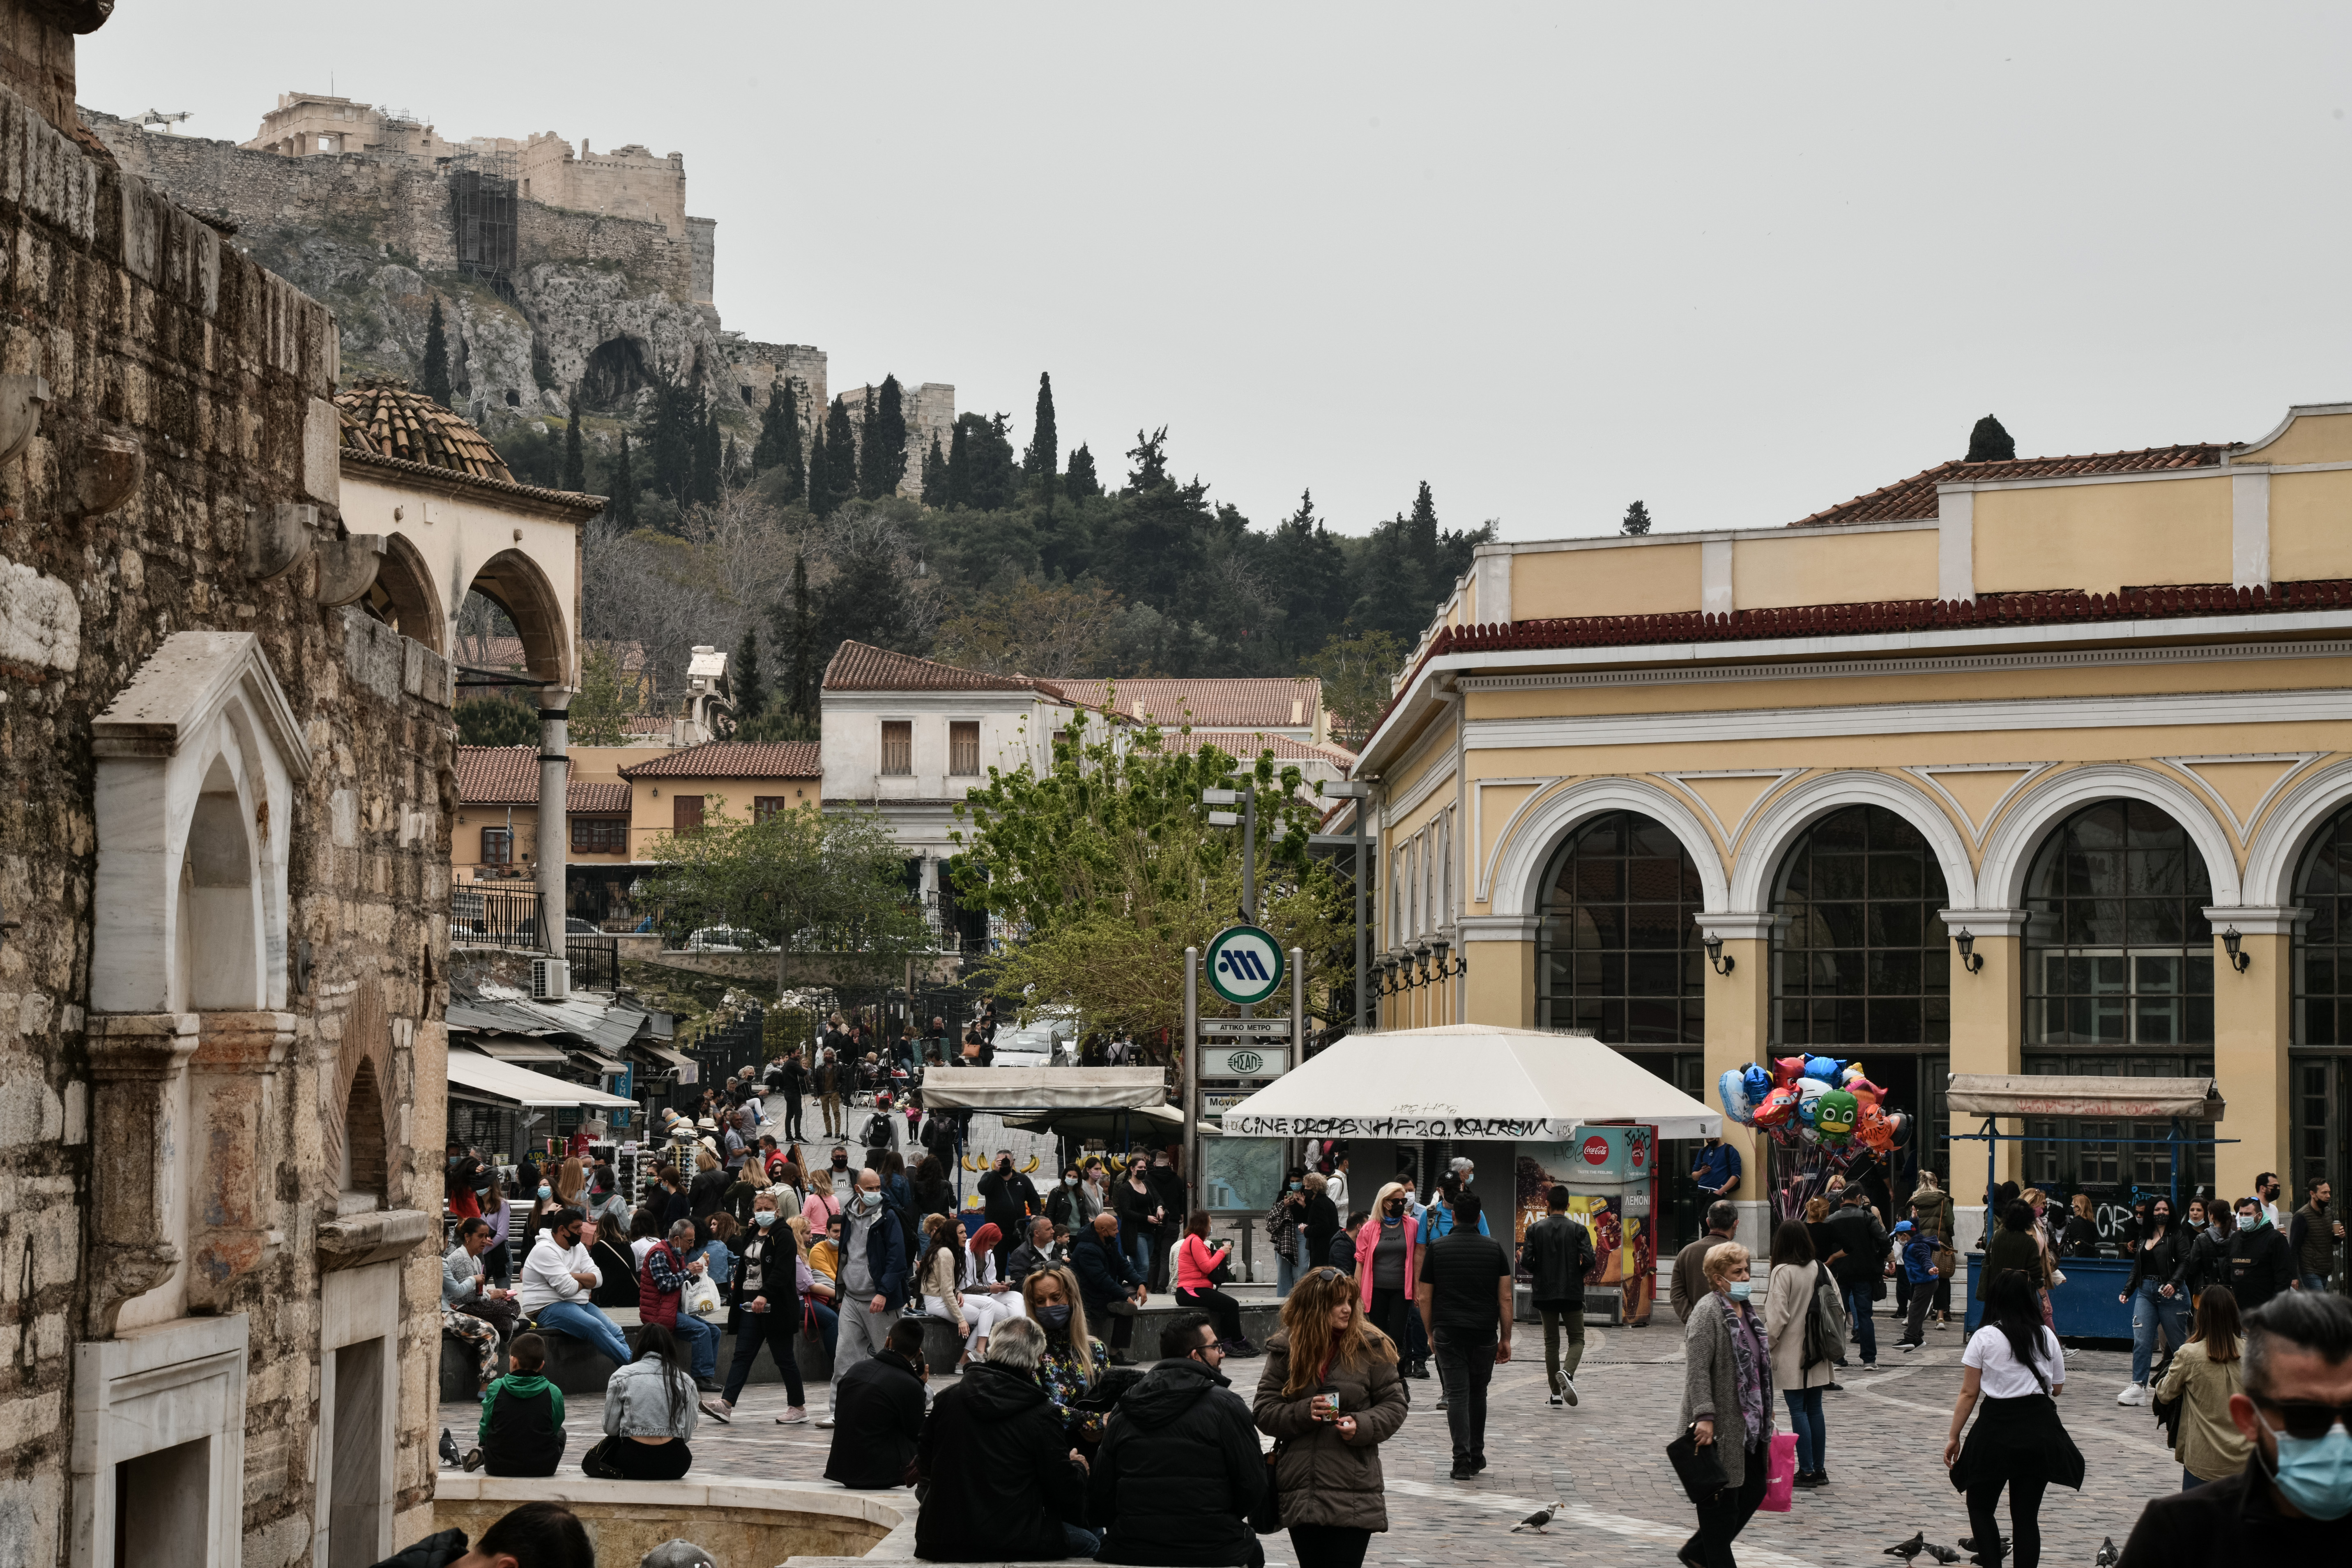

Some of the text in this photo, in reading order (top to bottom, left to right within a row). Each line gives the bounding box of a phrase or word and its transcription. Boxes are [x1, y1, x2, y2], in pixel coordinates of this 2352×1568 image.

[1234, 1054, 1257, 1071] ΗΣΑΠ
[1584, 1146, 1608, 1155] Coca-Cola
[1524, 1211, 1590, 1226] ΛΕΟΝΙ
